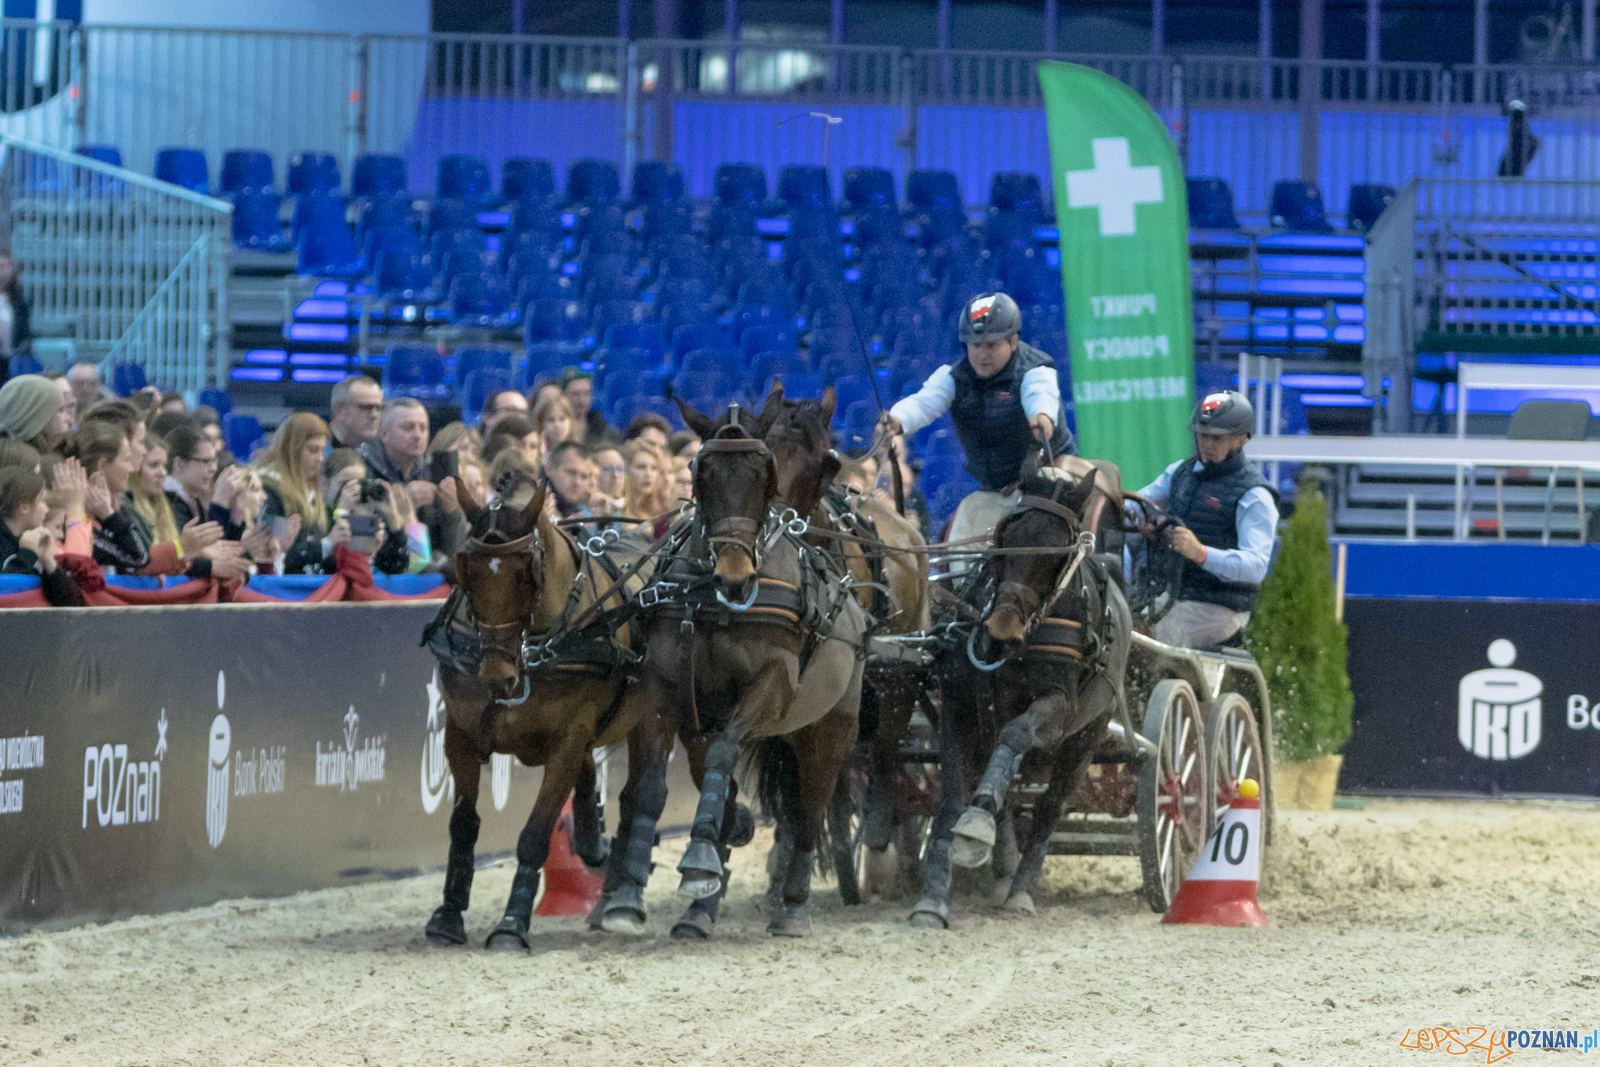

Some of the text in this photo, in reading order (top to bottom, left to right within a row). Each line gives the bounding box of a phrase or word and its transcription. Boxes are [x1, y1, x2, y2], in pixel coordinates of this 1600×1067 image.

[234, 744, 286, 796] Bank Polski
[1210, 821, 1249, 865] 10
